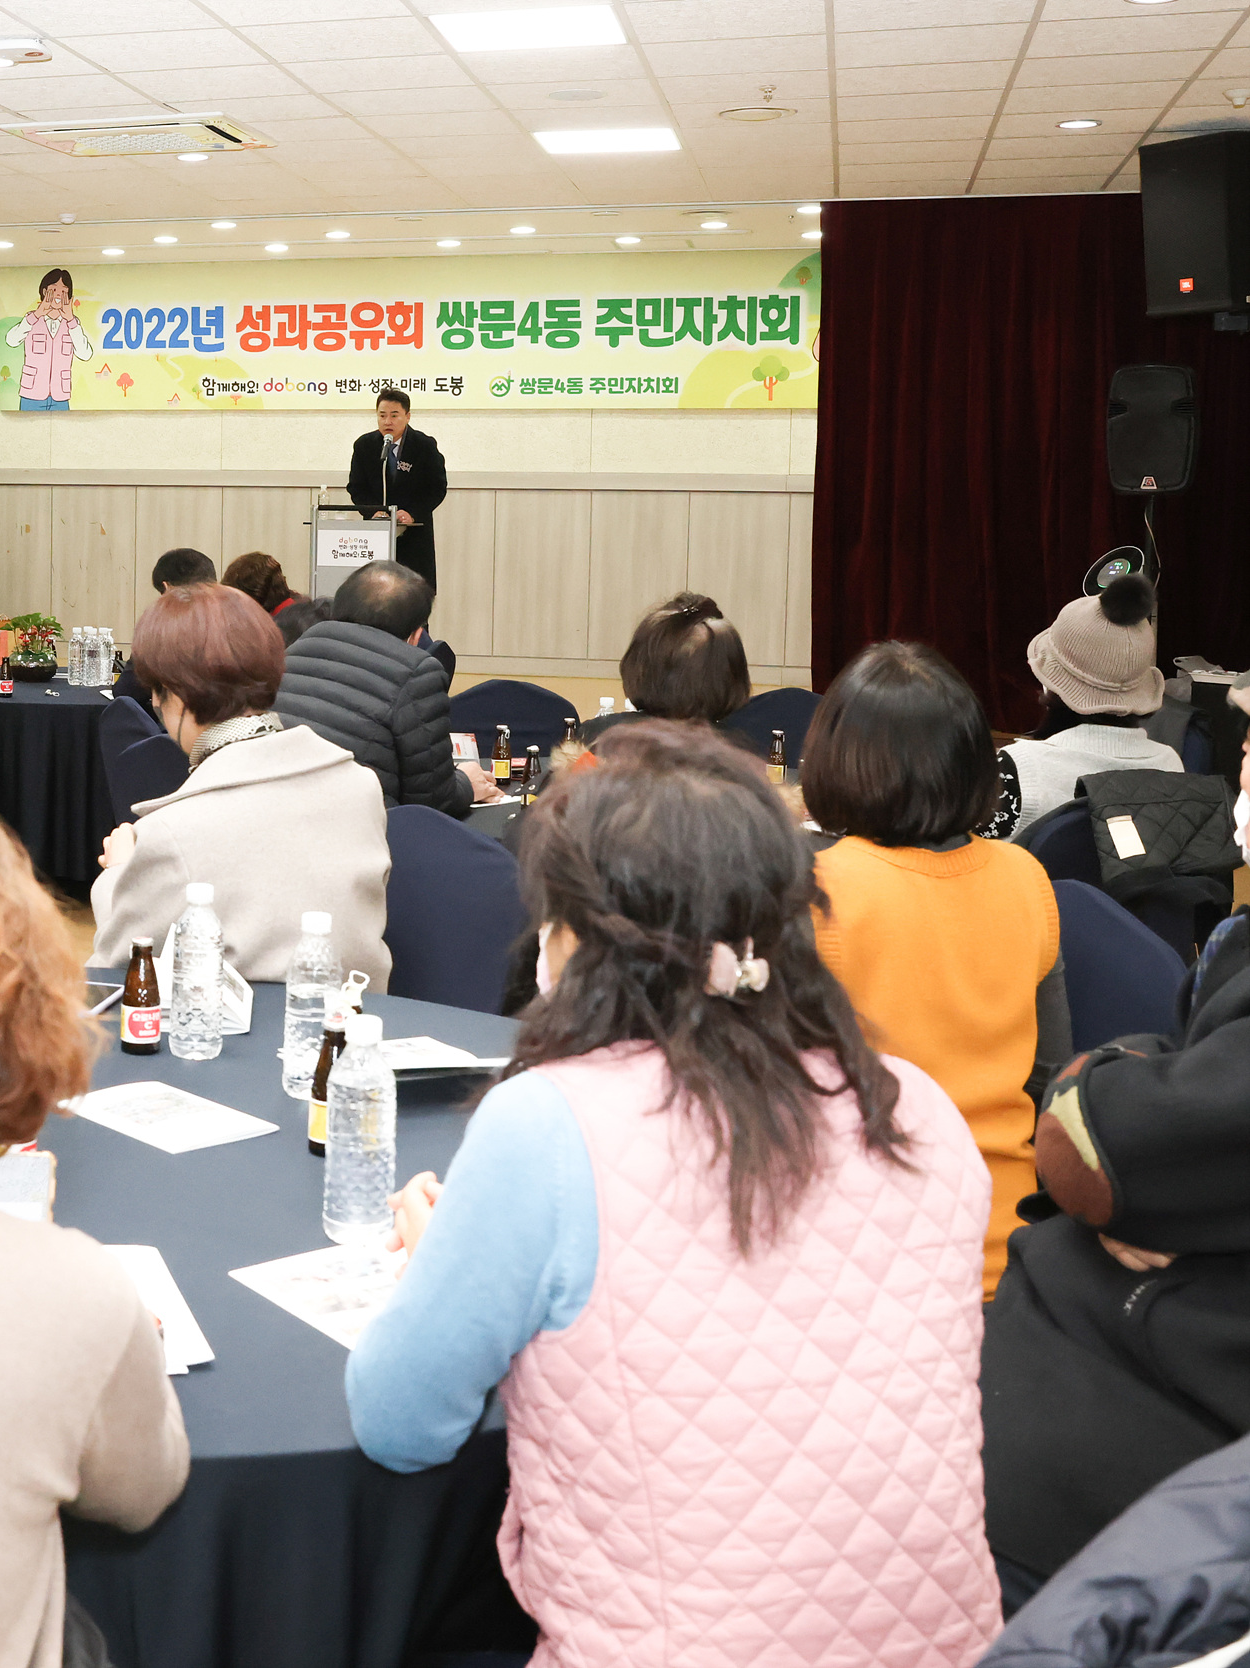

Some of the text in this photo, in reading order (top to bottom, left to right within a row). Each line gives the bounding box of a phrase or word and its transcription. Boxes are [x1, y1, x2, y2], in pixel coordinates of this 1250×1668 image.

[102, 294, 801, 353] 2022년 성과공유회 쌍문4동 주민자치회
[202, 377, 259, 396] 함께해요!
[263, 377, 328, 395] dobong
[434, 376, 464, 397] 도봉
[519, 376, 679, 394] 쌍문4동 주민자치회
